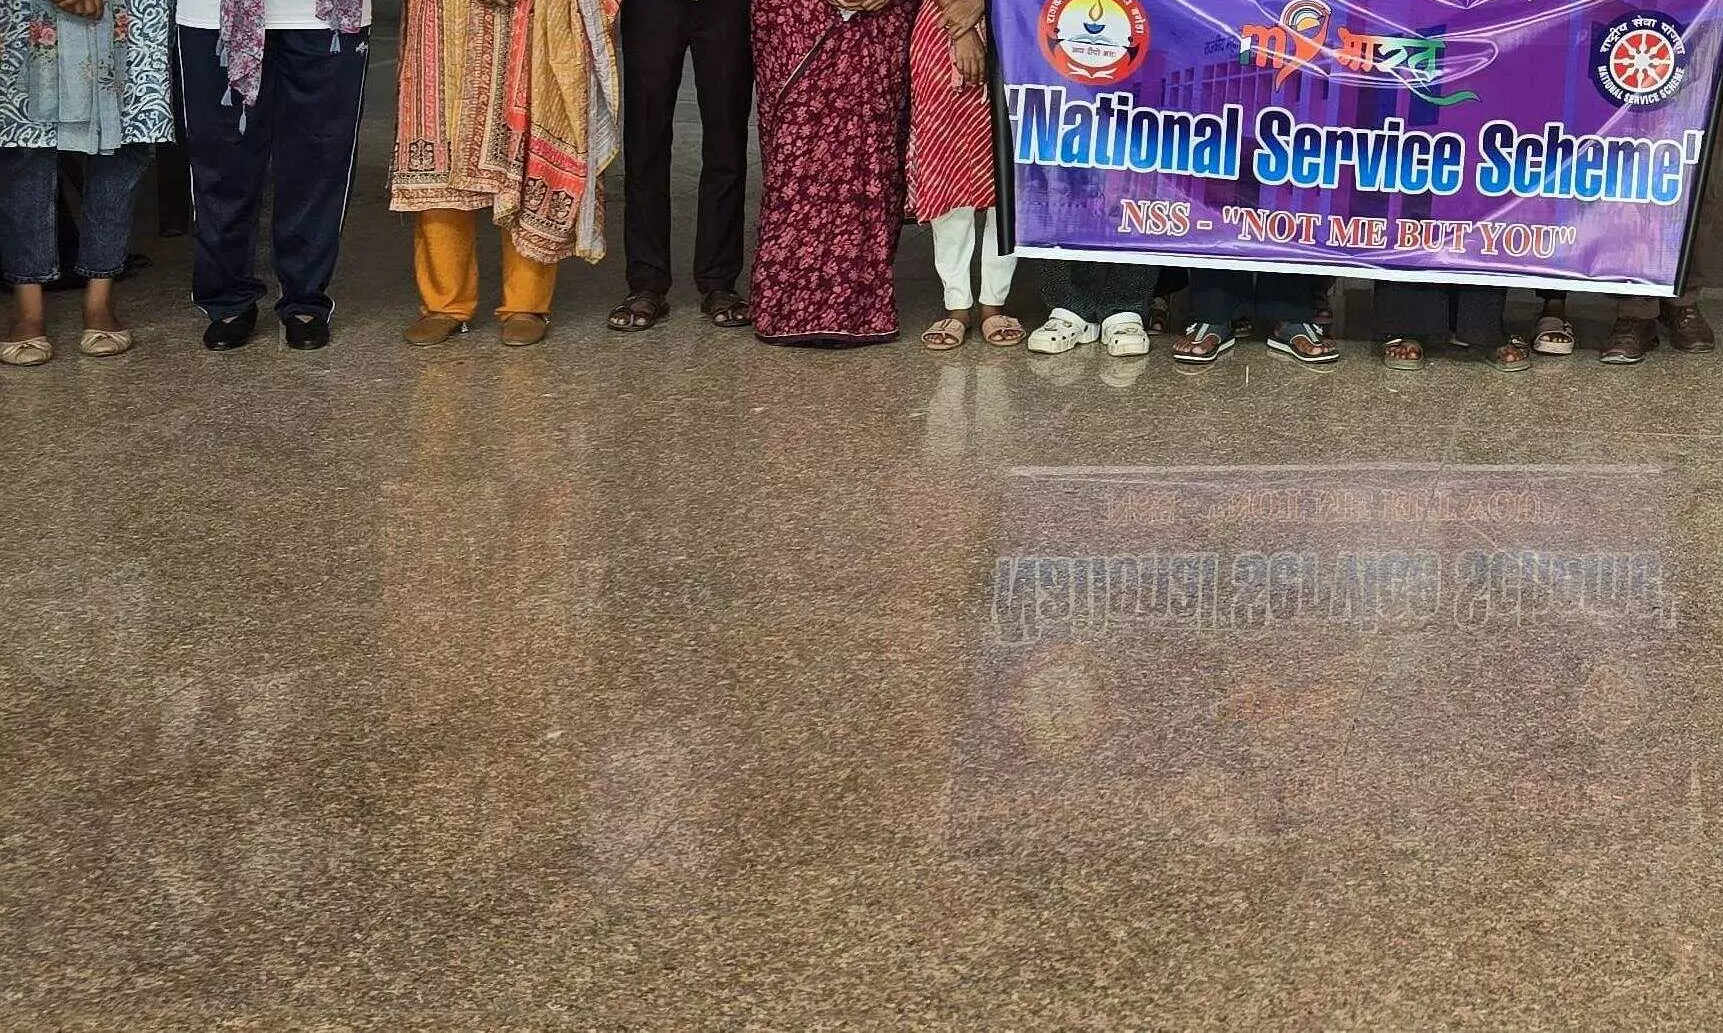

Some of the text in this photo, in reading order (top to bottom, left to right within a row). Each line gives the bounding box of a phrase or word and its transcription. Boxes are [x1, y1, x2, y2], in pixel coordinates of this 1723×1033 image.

[1631, 15, 1658, 28] सेवा
[1597, 65, 1686, 105] NATIONAL SERVICE SCHEME
[1253, 104, 1464, 194] Service
[1118, 200, 1193, 240] NSS
[1222, 207, 1323, 246] "NOT
[1328, 214, 1389, 249] ME
[1394, 217, 1472, 254] BUT
[1472, 220, 1577, 262] YOU"
